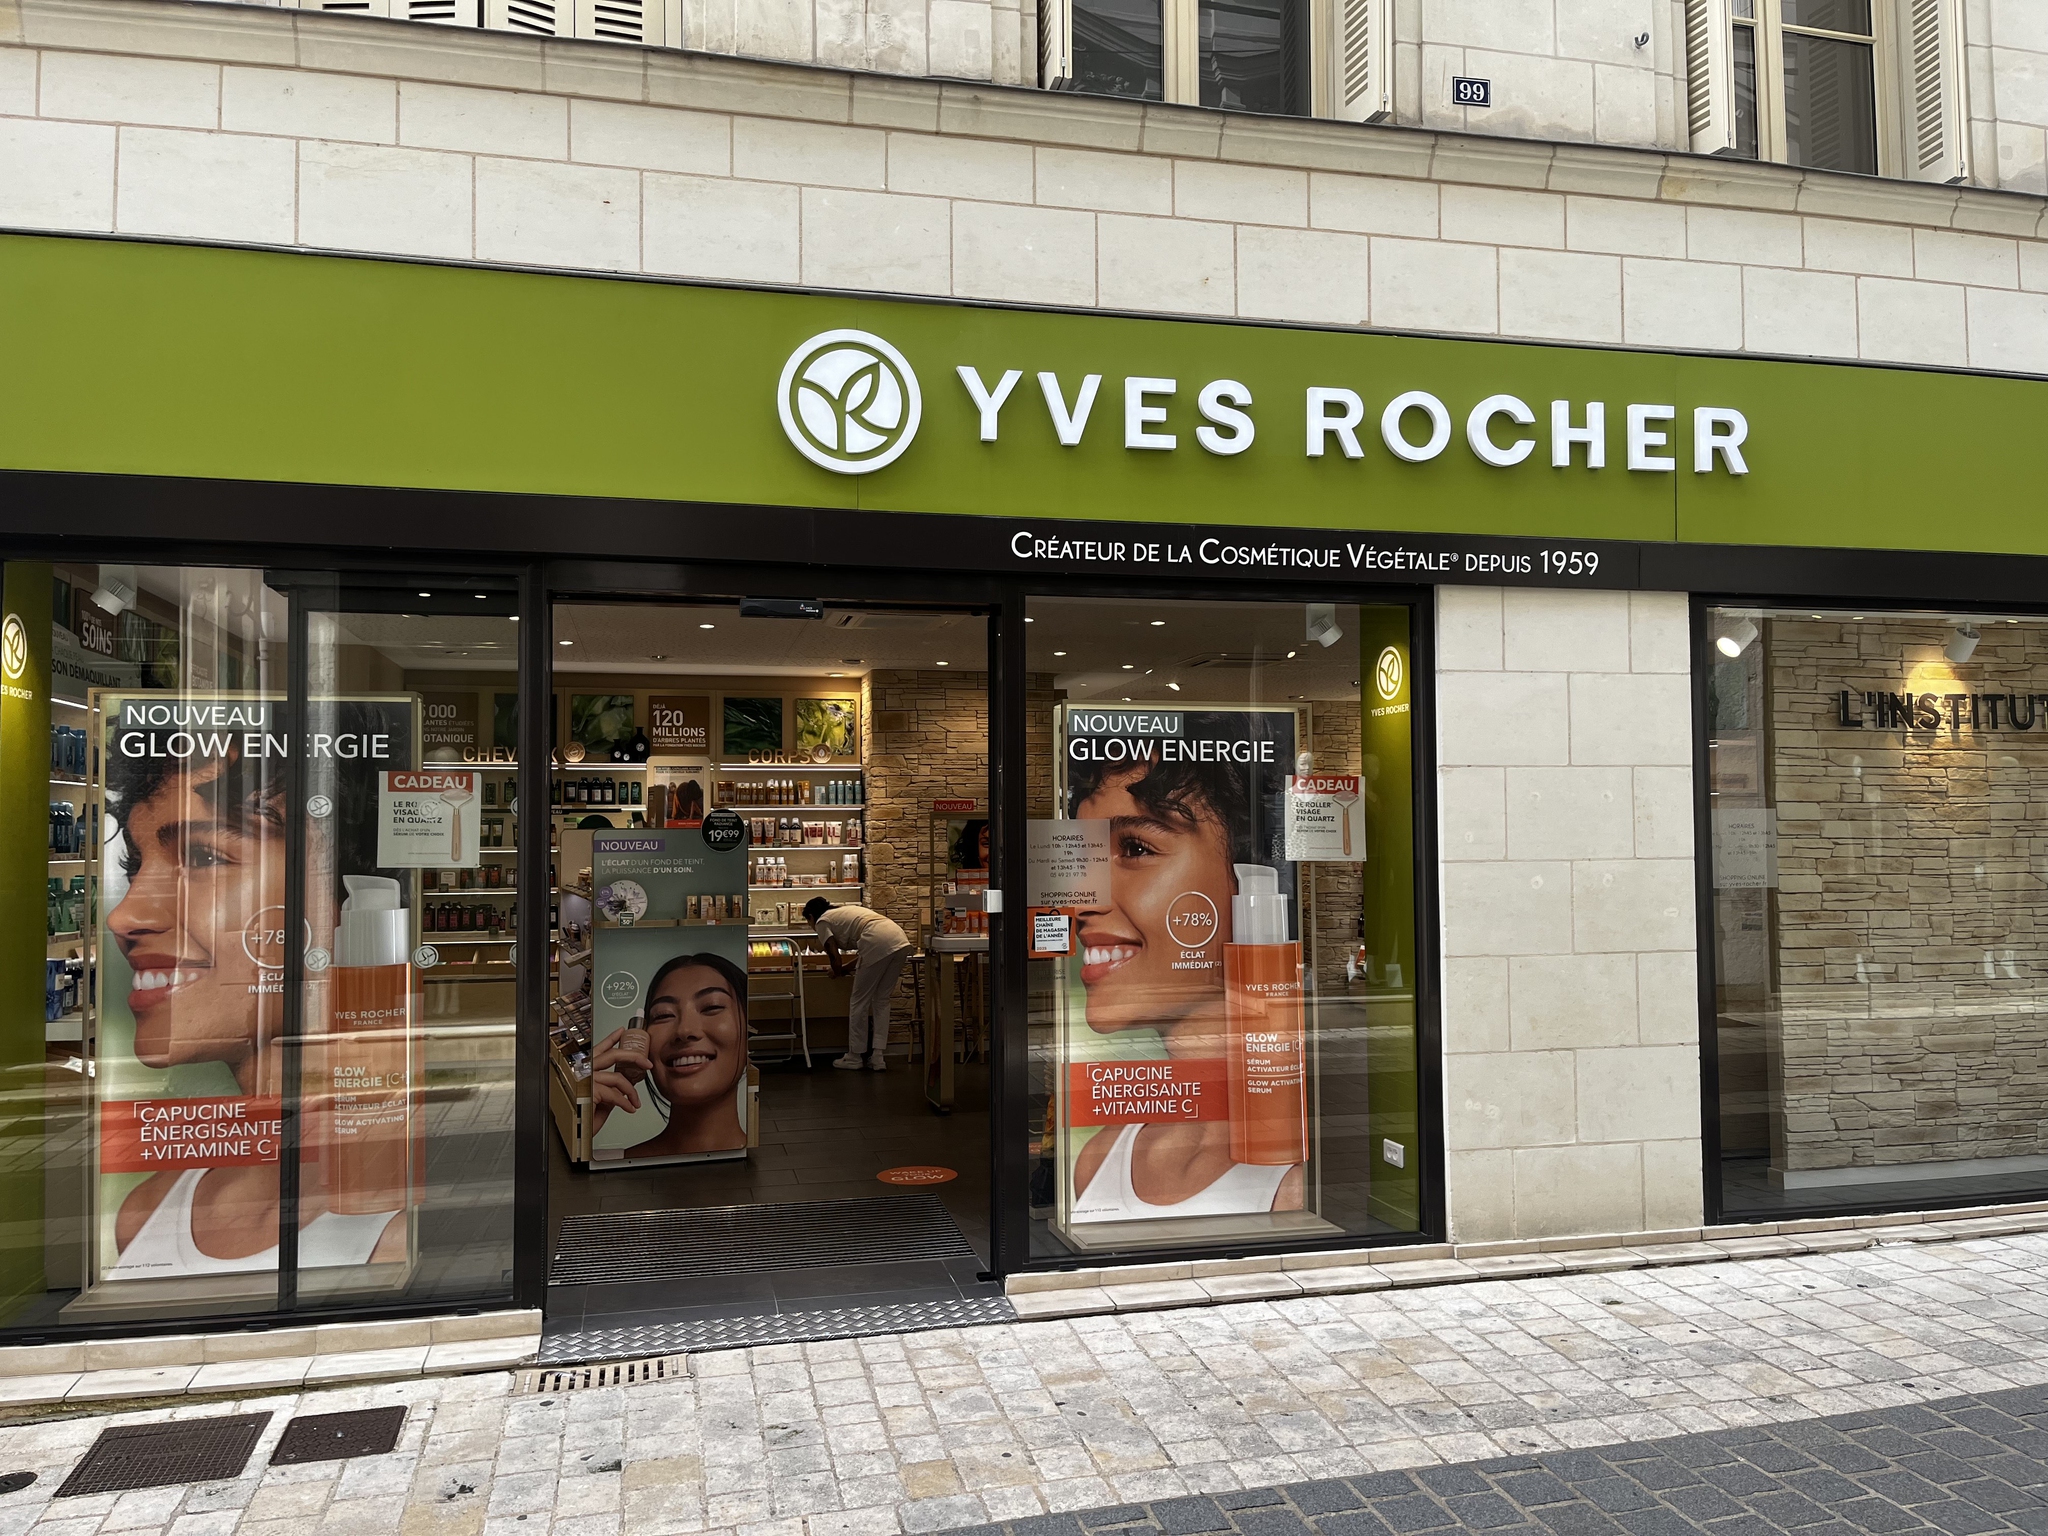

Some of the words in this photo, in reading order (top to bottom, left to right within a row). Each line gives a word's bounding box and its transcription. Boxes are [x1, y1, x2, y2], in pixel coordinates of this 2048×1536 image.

[1459, 81, 1485, 102] 99
[955, 365, 1256, 457] YVES
[1306, 386, 1748, 474] ROCHER
[1011, 531, 1126, 562] CRÉATEUR
[1133, 543, 1160, 563] DE
[1167, 544, 1192, 564] LA
[1199, 538, 1341, 569] COSMÉTIQUE
[1465, 553, 1532, 573] DEPUIS
[1540, 549, 1599, 576] 1959
[82, 622, 113, 655] SOINS
[9, 686, 33, 700] ROCHER
[126, 705, 265, 726] NOUVEAU
[1370, 707, 1385, 717] YVES
[1385, 703, 1410, 715] ROCHER
[653, 709, 684, 727] 120
[1073, 714, 1178, 733] NOUVEAU
[423, 733, 474, 743] OTANIQUE
[652, 727, 706, 737] MILLIONS
[119, 732, 233, 758] GLOW
[680, 736, 707, 744] PLANTÉS
[749, 748, 811, 764] CORPS
[1069, 738, 1155, 761] GLOW
[1162, 739, 1275, 763] ENERGIE
[393, 775, 467, 789] CADEAU
[1297, 779, 1355, 791] CADEAU
[393, 816, 405, 824] EN
[708, 829, 740, 842] 19€99
[601, 840, 659, 851] NOUVEAU
[601, 858, 630, 867] L'ÉCLAT
[630, 859, 649, 867] D'UN
[650, 858, 671, 867] FOND
[672, 858, 683, 866] DE
[601, 867, 610, 876] LA
[610, 867, 652, 876] PUISSANCE
[653, 866, 672, 874] D'UN
[673, 866, 694, 874] SOIN.
[1040, 891, 1073, 899] SHOPPING
[1051, 898, 1098, 907] yves-rocher.fr
[1172, 912, 1213, 927] +78%
[250, 929, 285, 945] +78
[1180, 950, 1206, 959] ÉCLAT
[1171, 960, 1214, 970] IMMÉDIAT
[259, 971, 285, 982] ÉCLA
[248, 983, 285, 994] IMMÉD
[606, 981, 635, 991] +92%
[1245, 983, 1269, 992] YVES
[334, 1011, 357, 1020] YVES
[360, 1008, 406, 1019] ROCHER
[1245, 1033, 1278, 1043] GLOW
[1246, 1042, 1291, 1053] ENERGIE
[1246, 1058, 1271, 1066] SÉRUM
[334, 1066, 366, 1077] GLOW
[1091, 1066, 1173, 1082] CAPUCINE
[1247, 1065, 1289, 1073] ACTIVATEUR
[334, 1077, 383, 1088] ENERGIE
[1092, 1082, 1201, 1099] ÉNERGISANTE
[140, 1103, 247, 1123] CAPUCINE
[1092, 1099, 1177, 1116] +VITAMINE
[1181, 1098, 1193, 1113] C
[334, 1118, 354, 1126] GLOW
[356, 1114, 405, 1126] ACTIVATING
[140, 1120, 282, 1142] ÉNERGISANTE
[140, 1140, 252, 1160] +VITAMINE
[257, 1139, 271, 1155] C
